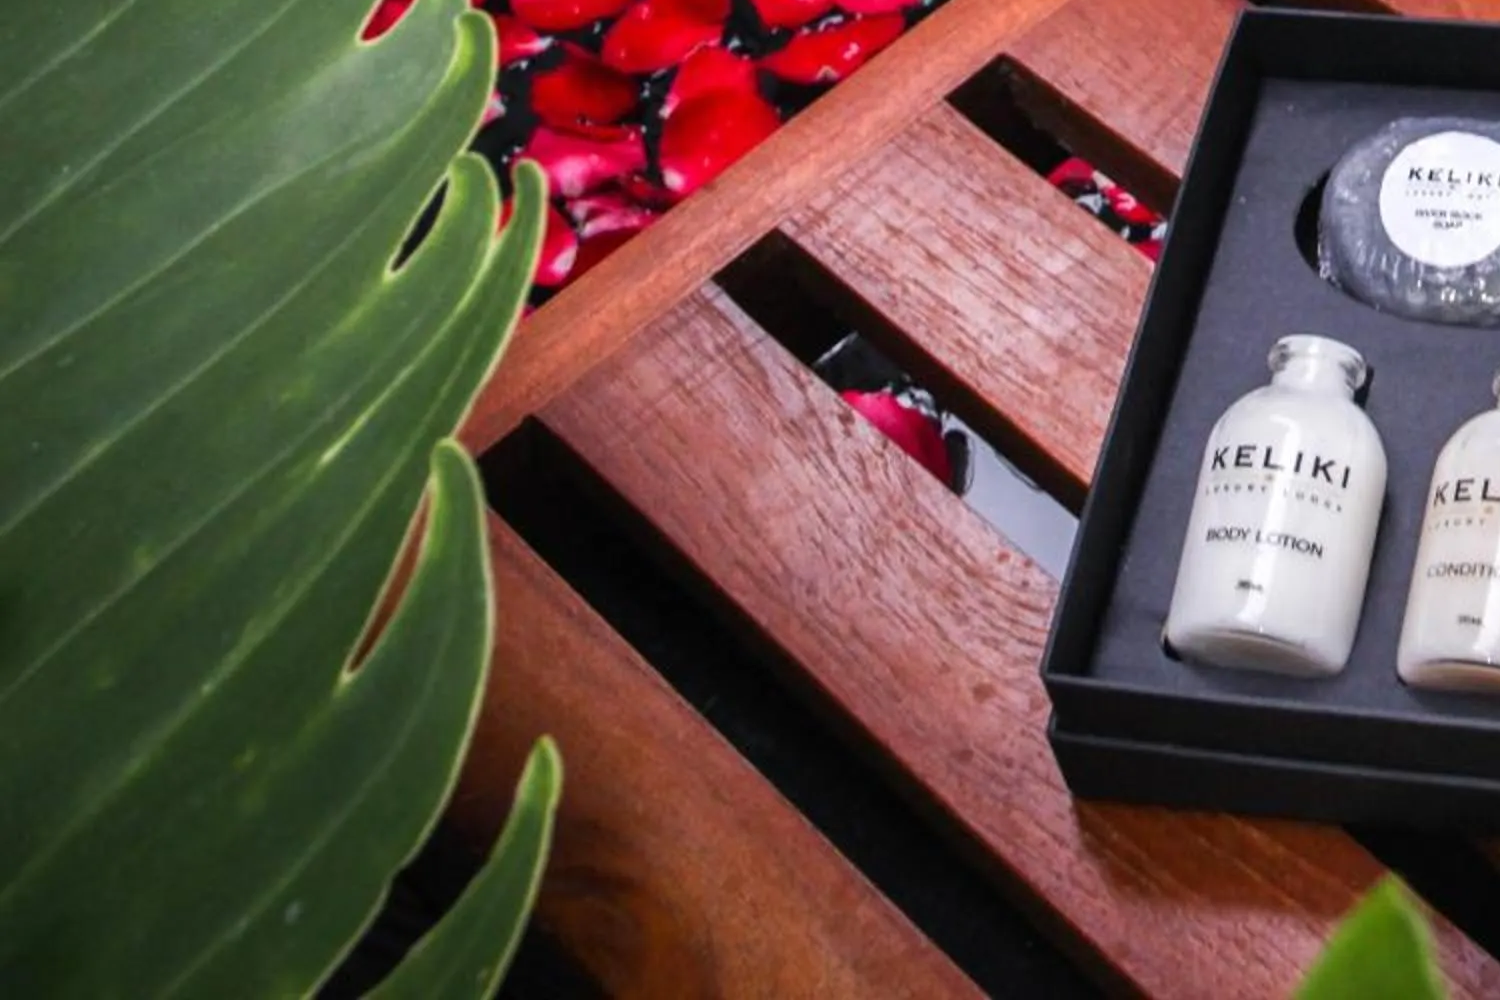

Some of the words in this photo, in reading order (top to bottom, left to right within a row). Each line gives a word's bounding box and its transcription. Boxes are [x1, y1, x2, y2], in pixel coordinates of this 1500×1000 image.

[1211, 445, 1351, 489] KELIKI
[1205, 526, 1251, 543] BODY
[1255, 530, 1324, 559] LOTION
